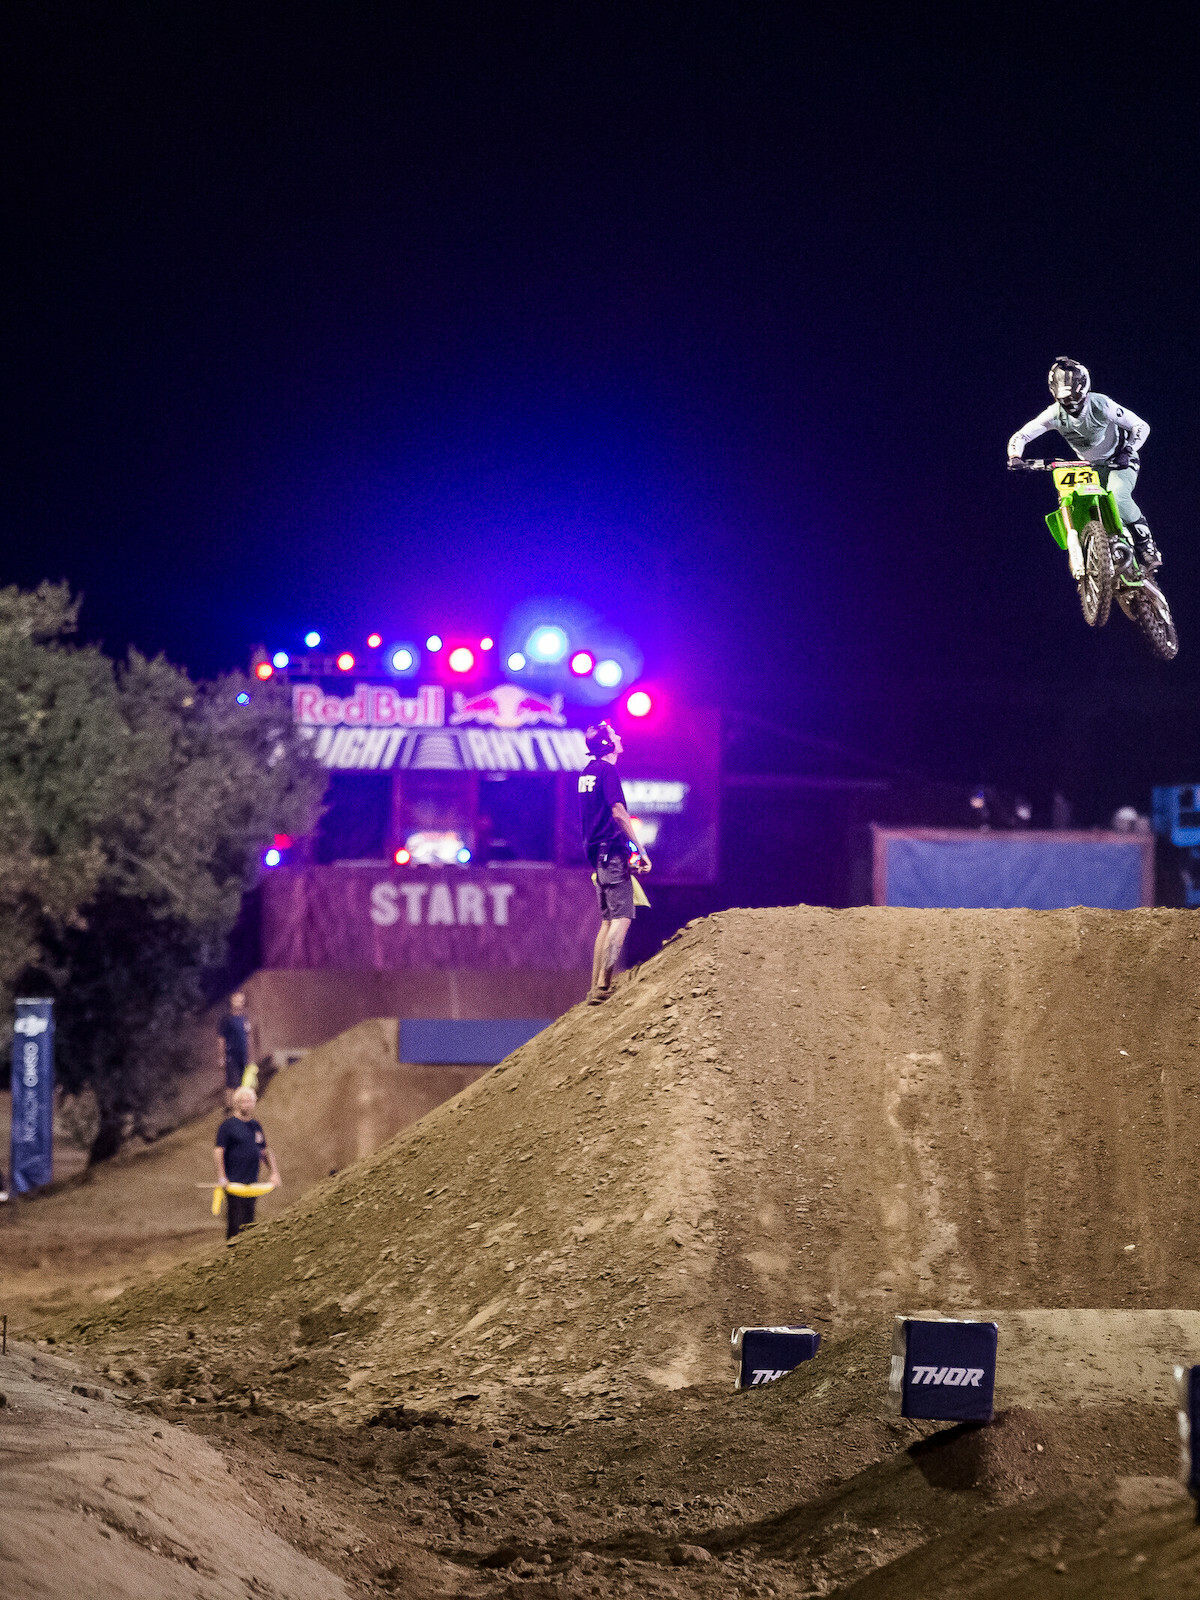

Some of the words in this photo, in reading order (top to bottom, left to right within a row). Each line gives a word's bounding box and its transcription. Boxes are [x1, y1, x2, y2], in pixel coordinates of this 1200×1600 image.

[1060, 471, 1094, 487] 43
[293, 685, 368, 725] Red
[371, 686, 445, 727] Bull
[369, 881, 514, 926] START
[911, 1366, 985, 1387] THOR
